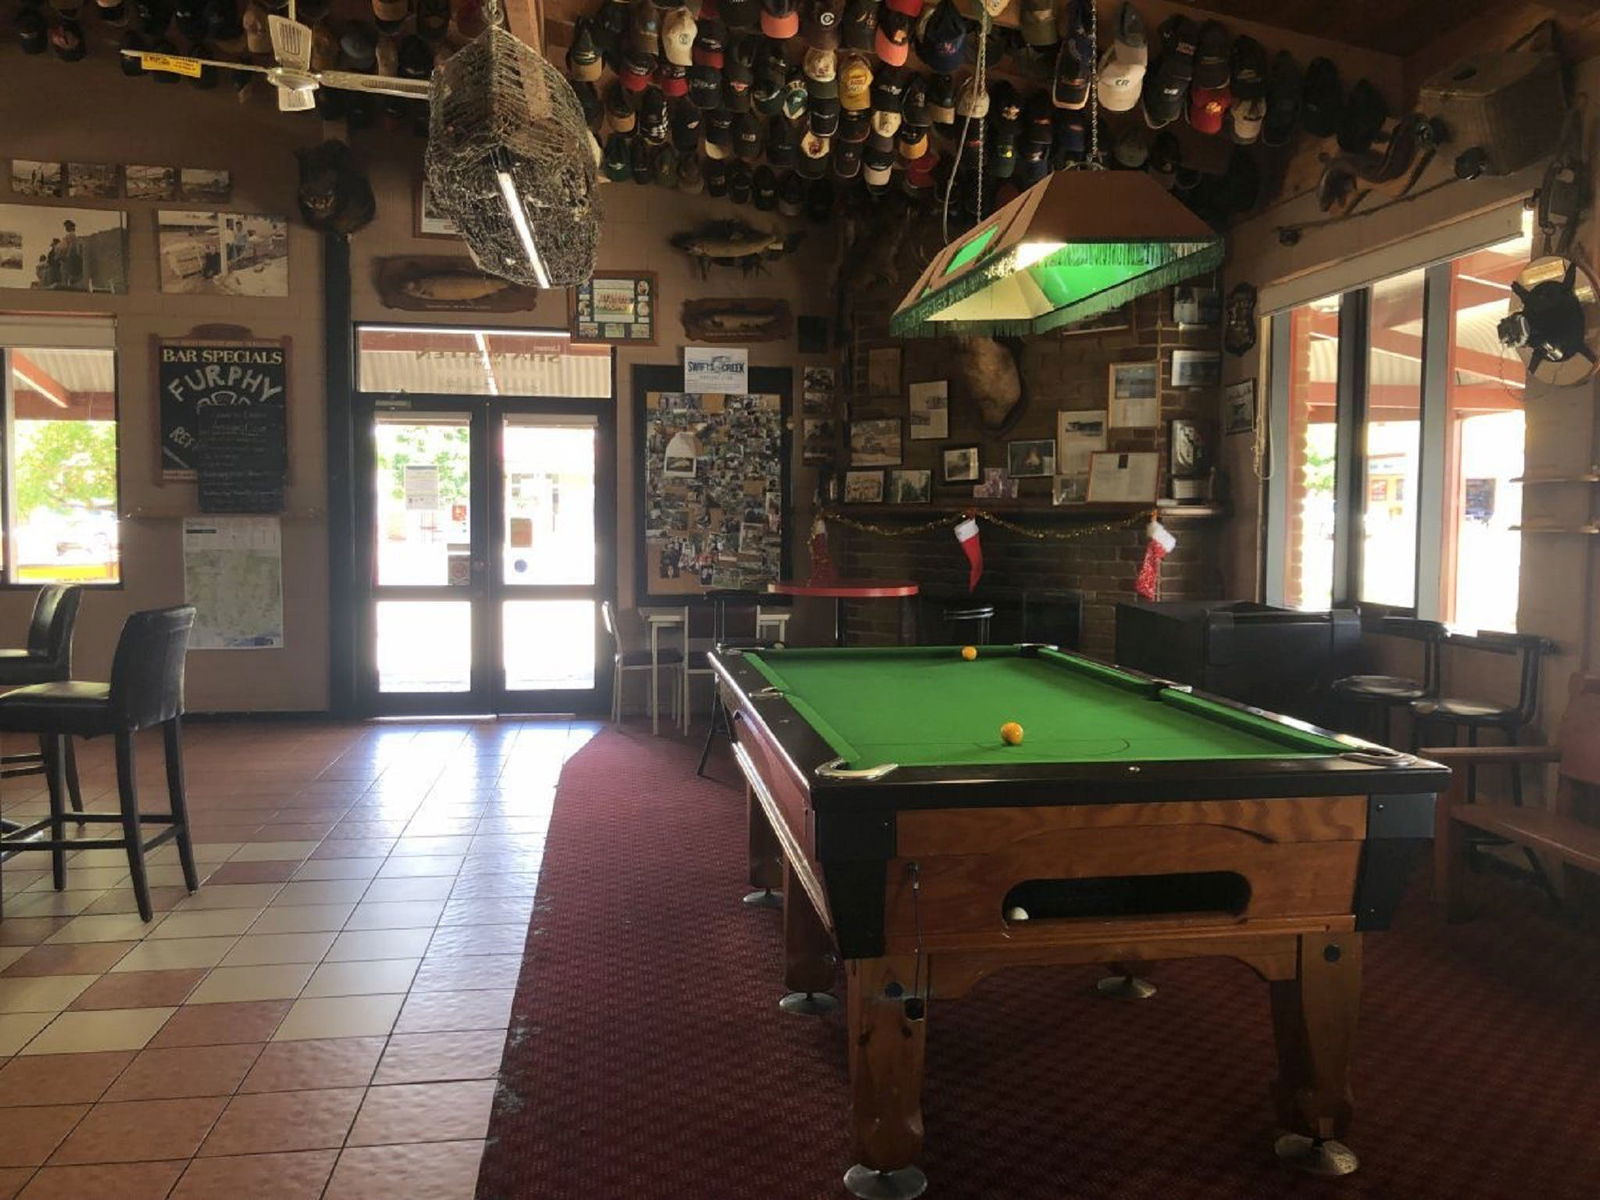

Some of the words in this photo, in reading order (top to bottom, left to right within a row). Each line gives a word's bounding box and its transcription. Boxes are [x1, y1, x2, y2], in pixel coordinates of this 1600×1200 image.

[162, 349, 197, 363] BAR
[202, 350, 283, 364] SPECIALS
[721, 361, 745, 374] CREEK
[168, 364, 283, 402] FURPHY
